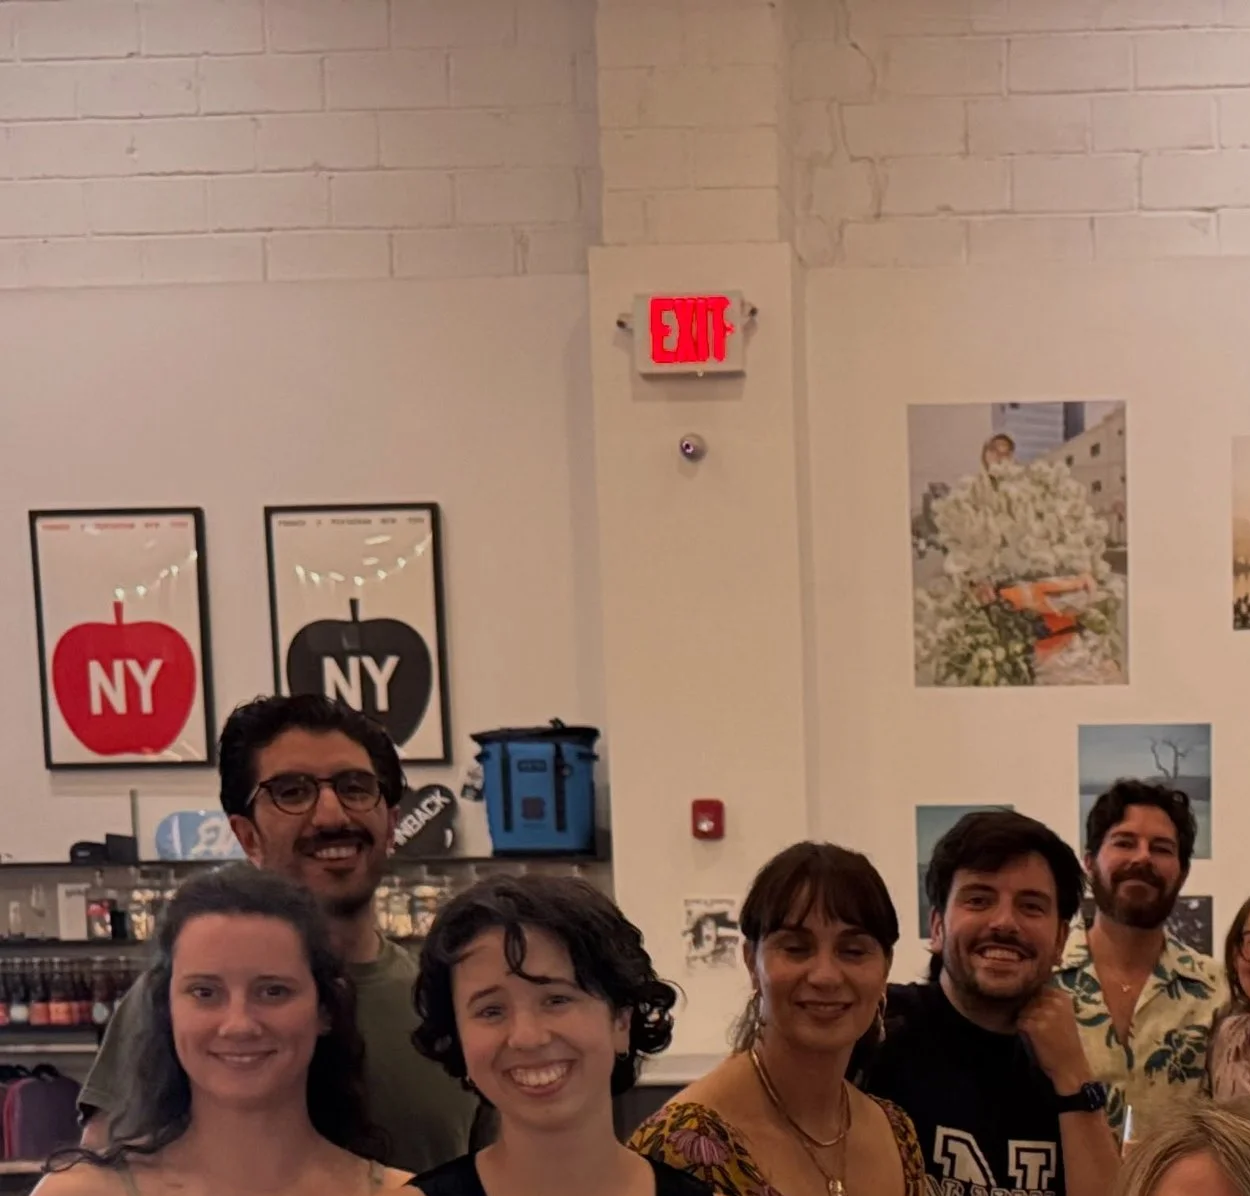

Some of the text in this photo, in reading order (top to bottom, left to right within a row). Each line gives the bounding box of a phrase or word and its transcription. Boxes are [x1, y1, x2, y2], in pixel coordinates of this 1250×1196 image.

[650, 296, 734, 363] EXIT
[88, 659, 163, 715] NY
[322, 655, 399, 712] NY
